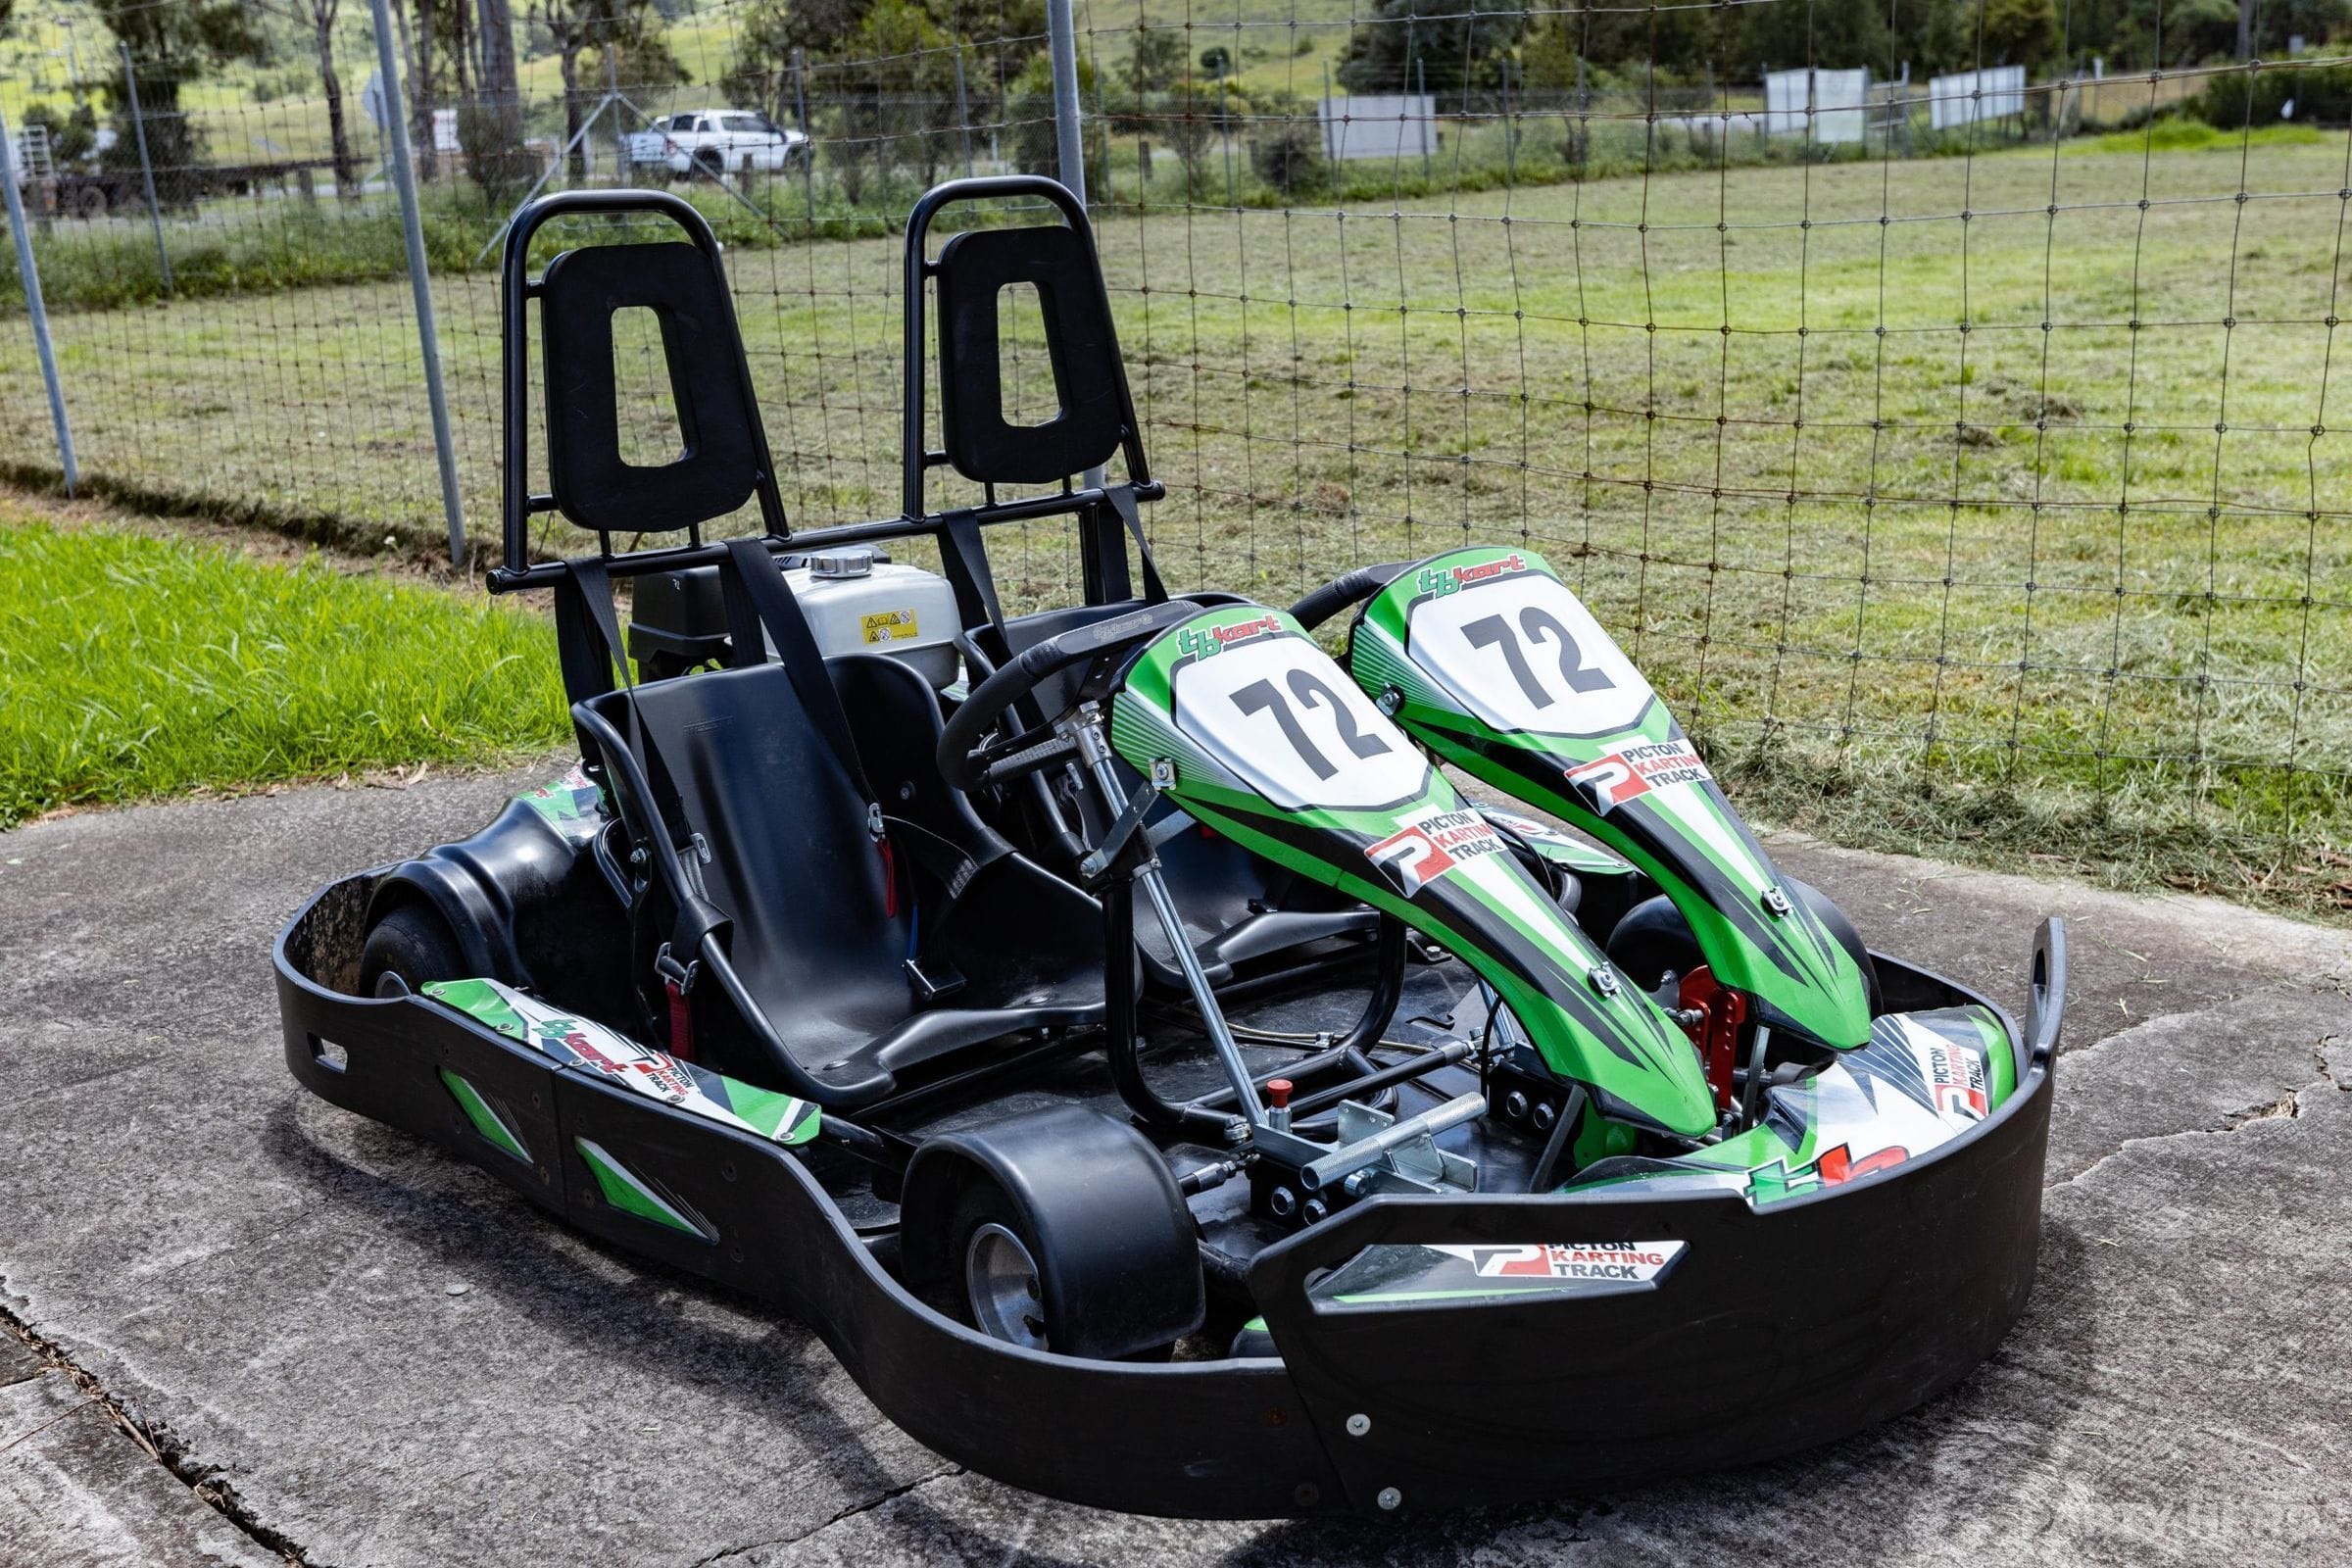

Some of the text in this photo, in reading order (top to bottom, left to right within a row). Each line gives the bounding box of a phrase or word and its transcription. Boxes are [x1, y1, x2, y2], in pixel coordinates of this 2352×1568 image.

[1459, 606, 1617, 710] 72
[1228, 668, 1395, 782] 72
[1622, 742, 1685, 762] PICTON
[1633, 754, 1701, 775] KARTIN
[1645, 767, 1707, 787] TRACK
[1417, 811, 1475, 835] PICTON
[1433, 822, 1494, 849] KARTIN
[1447, 838, 1504, 860] TRACK
[1930, 1047, 1950, 1084] PICTON
[1945, 1044, 1969, 1087] KARTING
[1965, 1056, 1984, 1092] TRACK
[647, 1072, 671, 1093] TRACK
[657, 1070, 689, 1097] KARTING
[666, 1066, 696, 1089] PICTON
[1550, 1250, 1665, 1266] KARTING
[1554, 1263, 1640, 1280] TRACK
